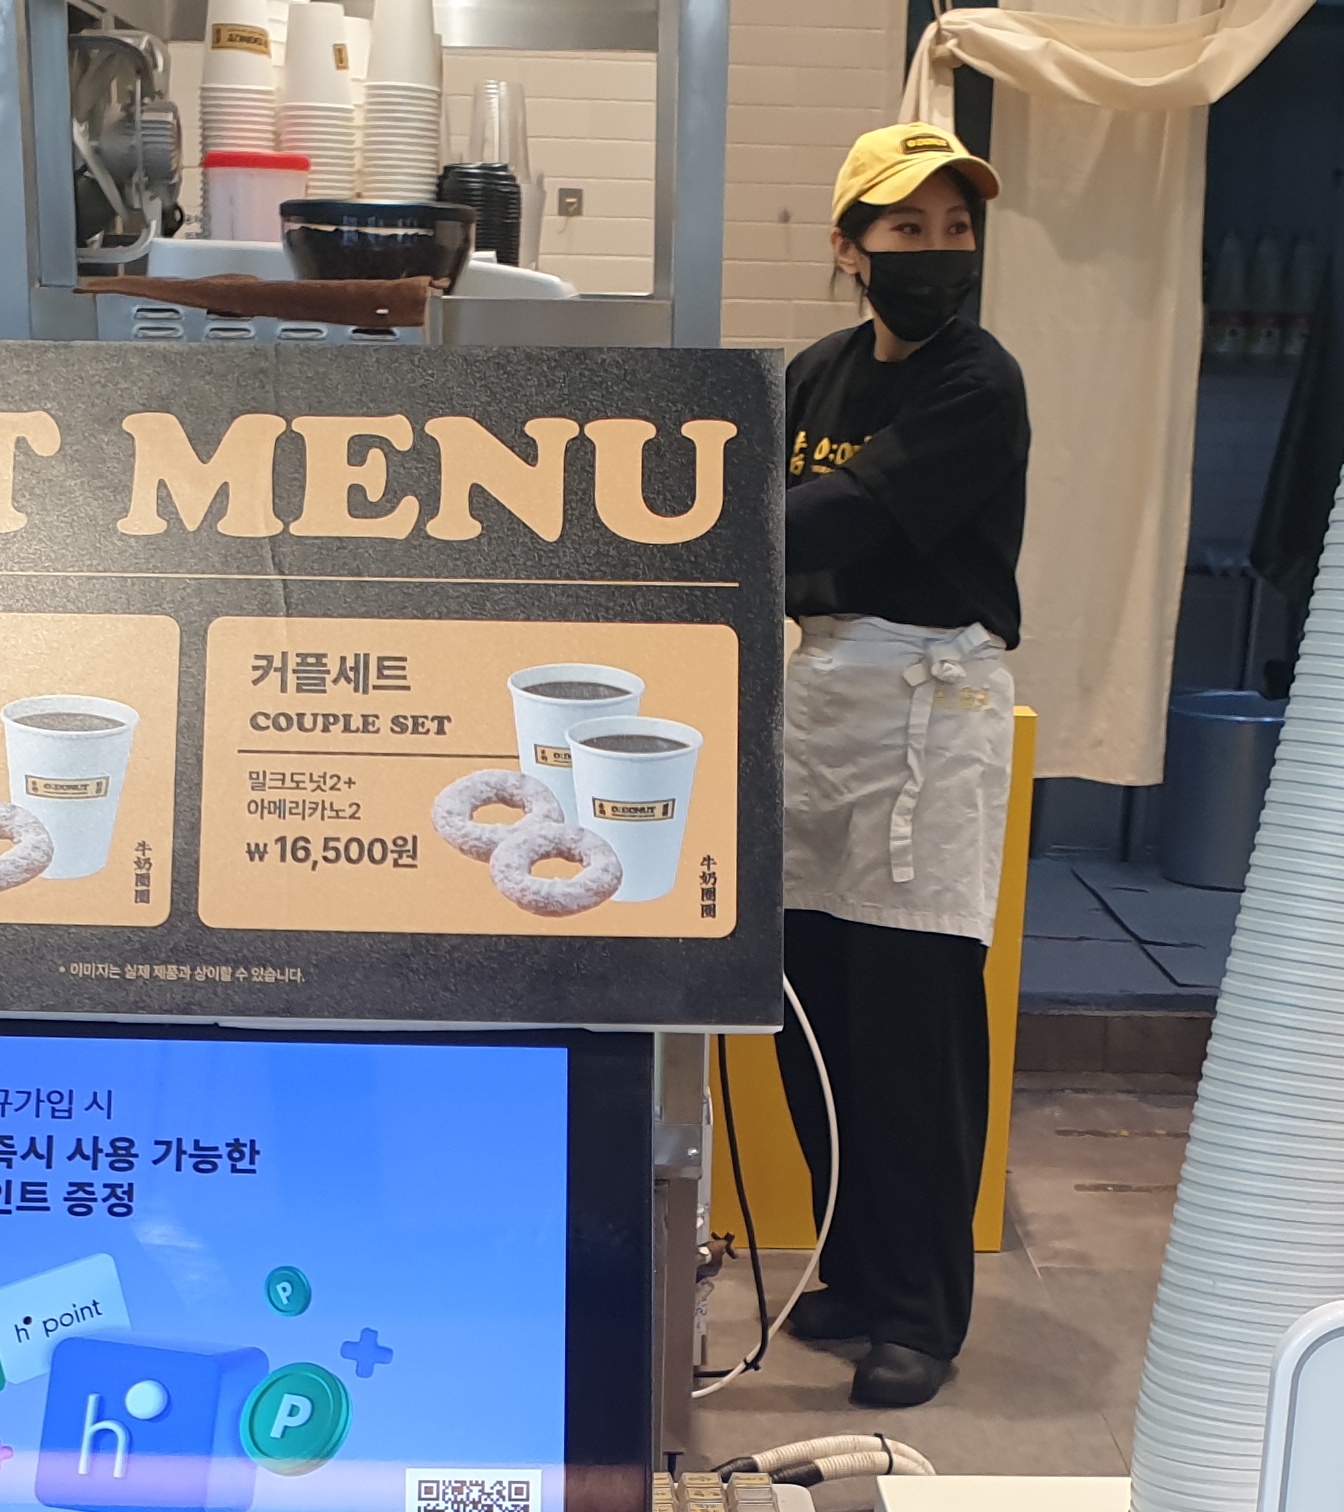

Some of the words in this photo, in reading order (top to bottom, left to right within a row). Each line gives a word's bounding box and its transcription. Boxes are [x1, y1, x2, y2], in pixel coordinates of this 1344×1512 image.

[116, 411, 738, 545] MENU
[251, 651, 412, 695] 커플세트
[249, 710, 380, 736] COUPLE
[389, 713, 452, 737] SET
[247, 769, 357, 794] 밀크도넛2+
[246, 798, 362, 822] 아메리카노2
[69, 962, 122, 980] 이미지는
[124, 963, 151, 980] 실제
[153, 964, 191, 981] 제품과
[194, 964, 233, 982] 상이할
[235, 966, 249, 982] 수
[251, 967, 306, 983] 있습니다.
[84, 1088, 113, 1120] 시
[66, 1135, 140, 1173] 사용
[151, 1136, 262, 1175] 가능한
[62, 1180, 135, 1217] 증정
[42, 1299, 104, 1338] point
